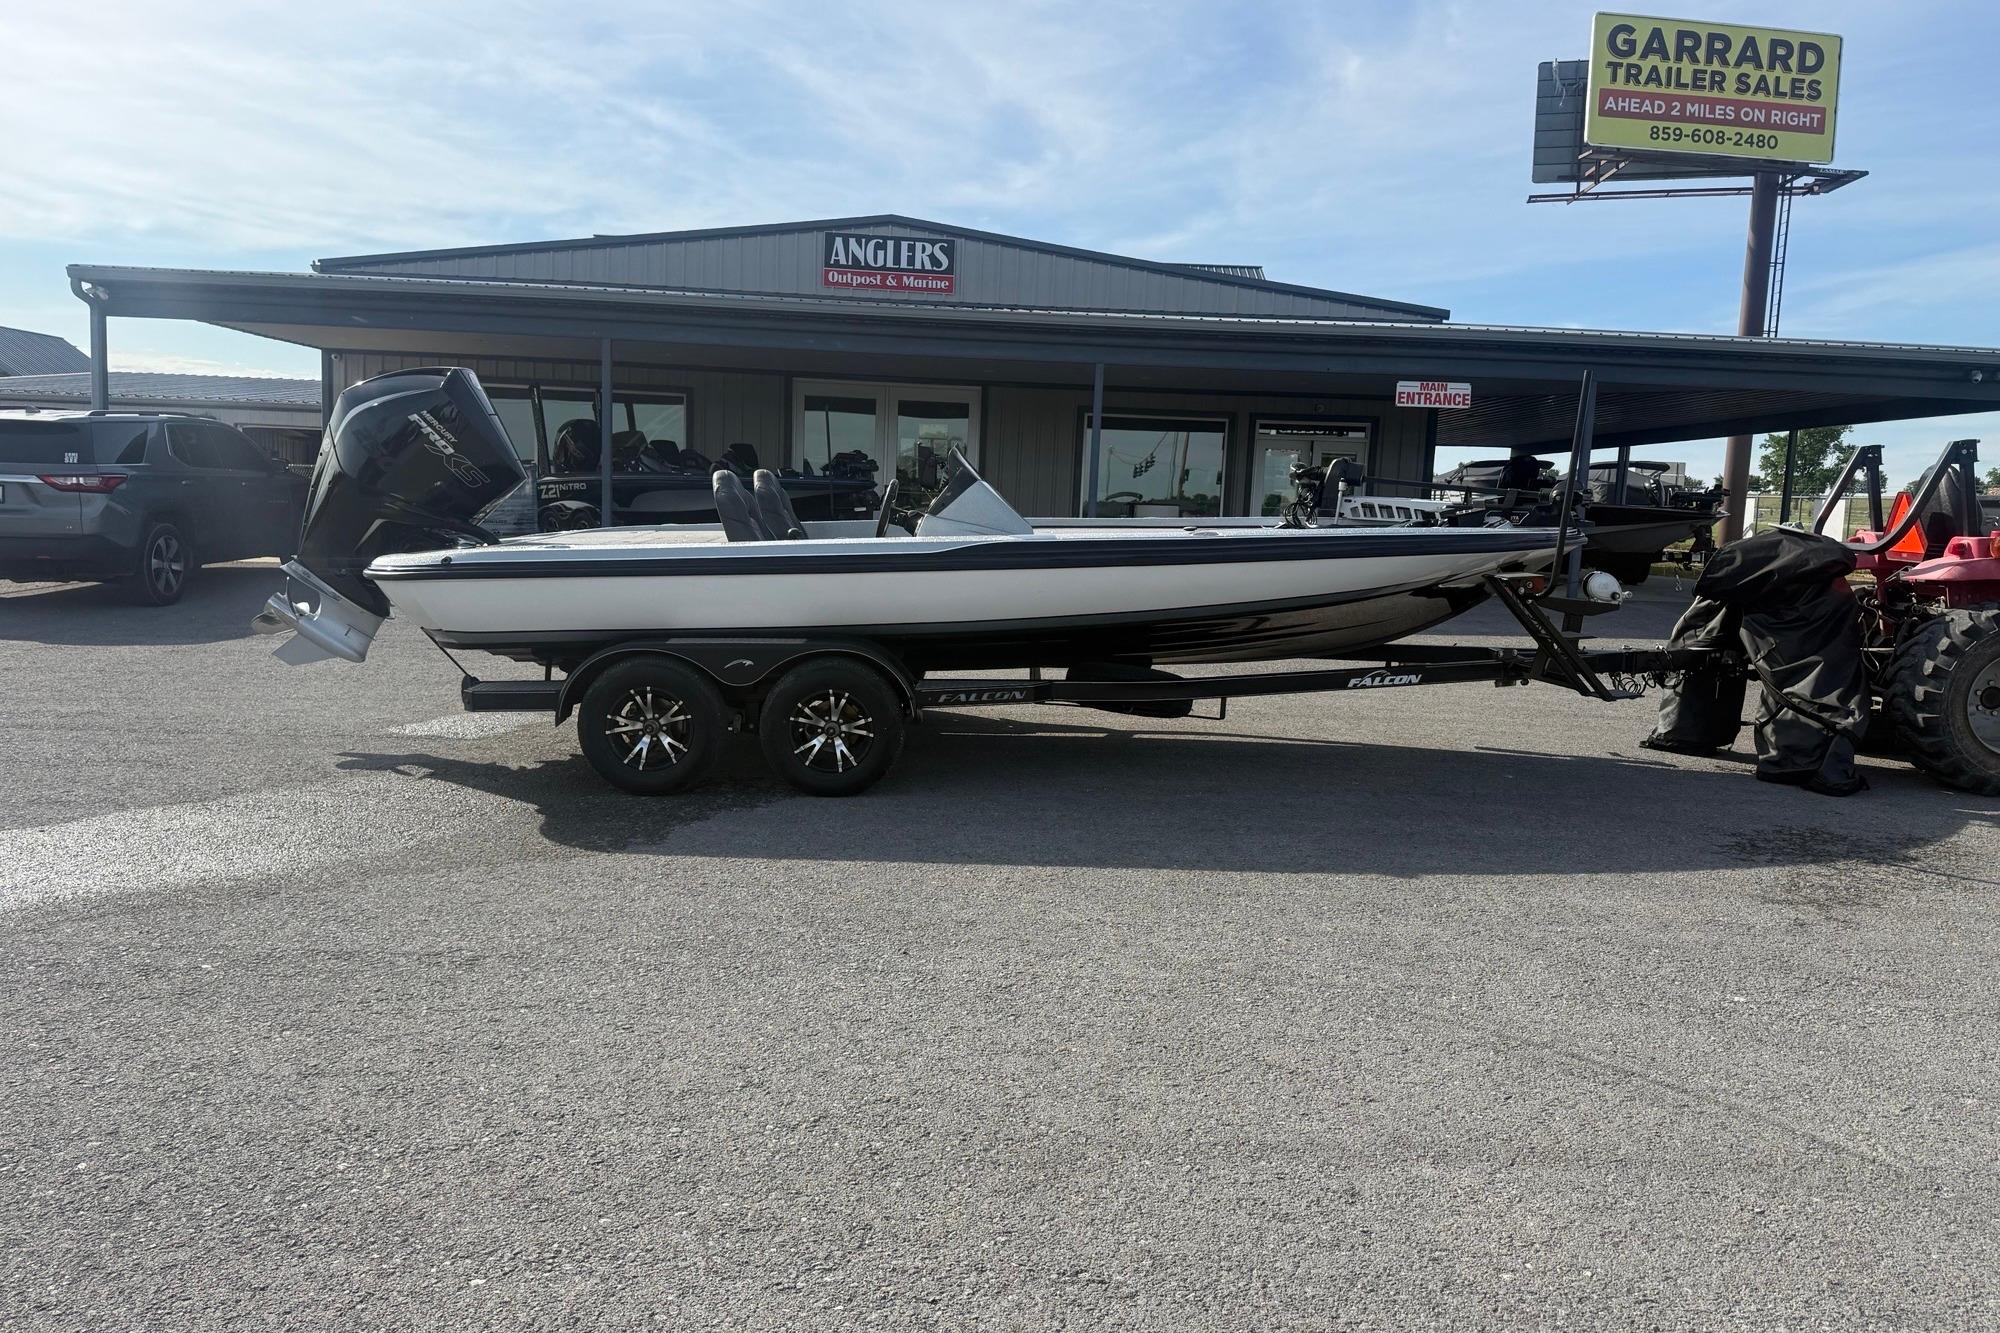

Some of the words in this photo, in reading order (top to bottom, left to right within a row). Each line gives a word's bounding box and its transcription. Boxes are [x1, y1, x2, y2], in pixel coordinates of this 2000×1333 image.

[1606, 24, 1825, 75] GARRARD
[1605, 61, 1726, 92] TRAILER
[1734, 72, 1823, 101] SALES
[1604, 97, 1666, 114] AHEAD
[1670, 102, 1681, 116] 2
[1686, 103, 1735, 120] MILES
[1740, 107, 1765, 123] ON
[1770, 110, 1822, 128] RIGHT
[1649, 125, 1779, 150] 859-608-2480
[830, 236, 949, 271] ANGLERS
[828, 271, 882, 286] Outpost
[886, 274, 898, 287] &
[902, 275, 949, 289] Marine
[1397, 391, 1470, 406] ENTRANCE
[1420, 382, 1448, 392] MAIN
[407, 413, 455, 455] PRO
[420, 410, 458, 442] MERCURY
[540, 484, 560, 499] Z21
[1347, 674, 1422, 688] FALCON
[938, 690, 1027, 703] FALCON
